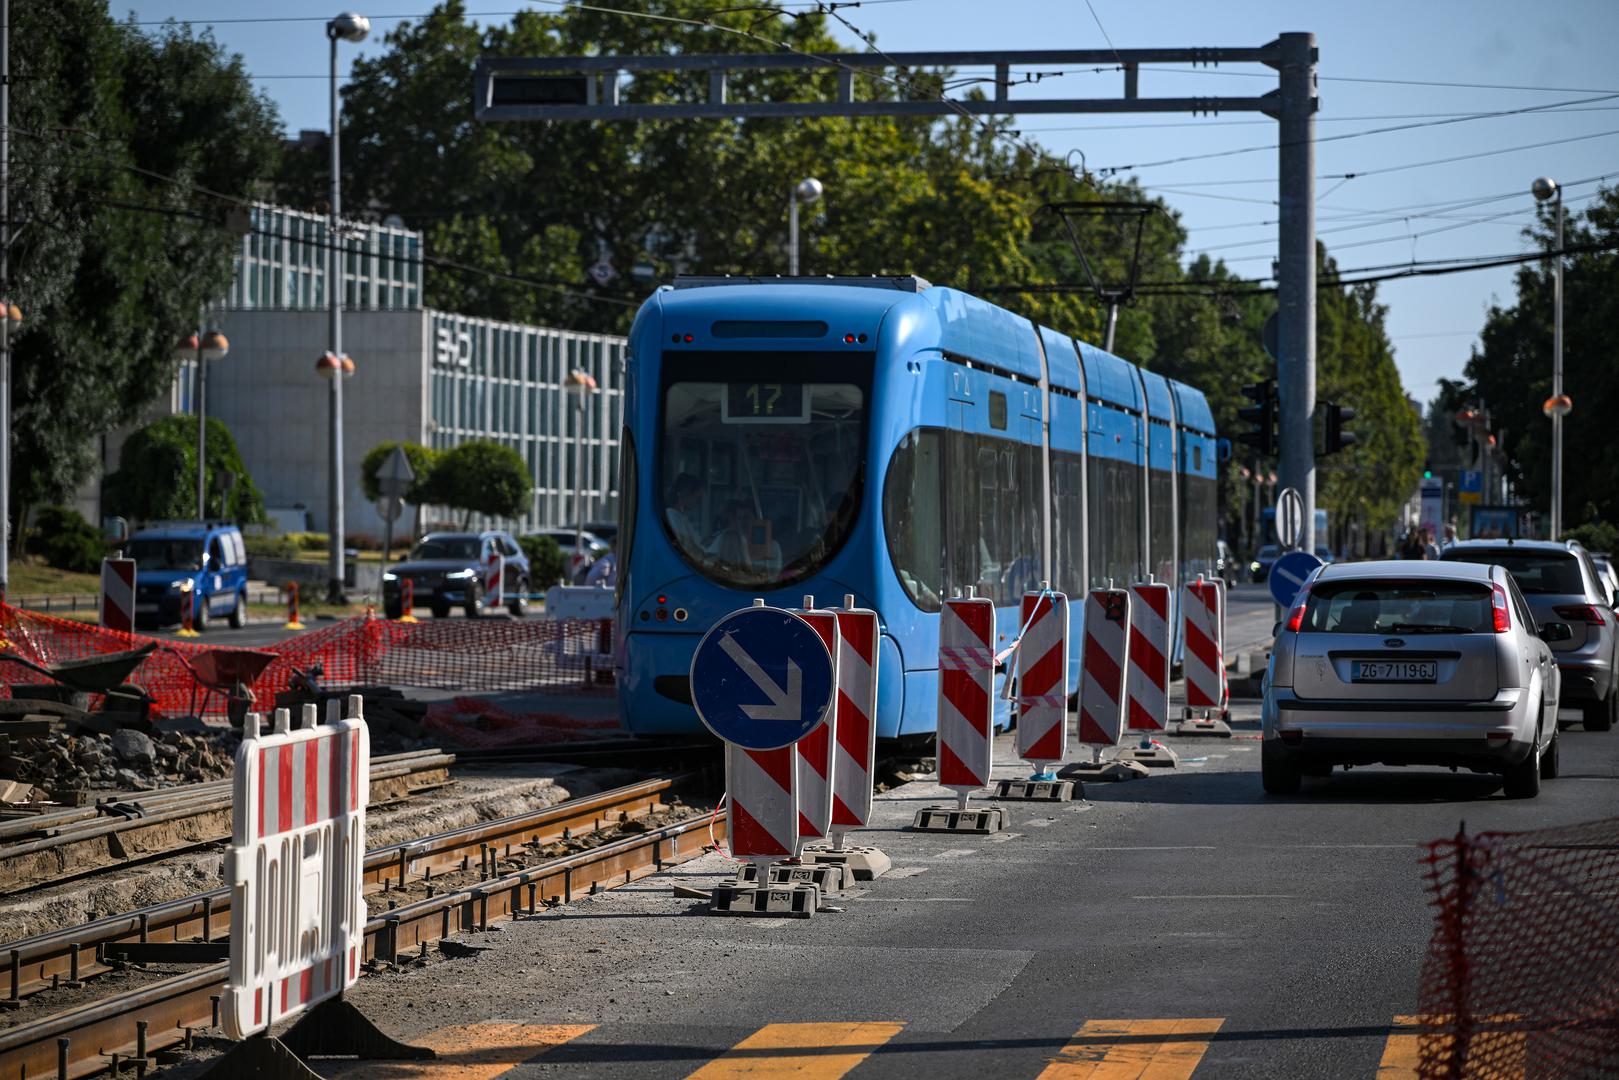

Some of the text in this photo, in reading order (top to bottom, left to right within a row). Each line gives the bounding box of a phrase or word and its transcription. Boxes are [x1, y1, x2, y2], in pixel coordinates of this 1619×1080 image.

[746, 383, 783, 415] 17
[1464, 471, 1477, 488] P
[1361, 664, 1377, 678] ZG
